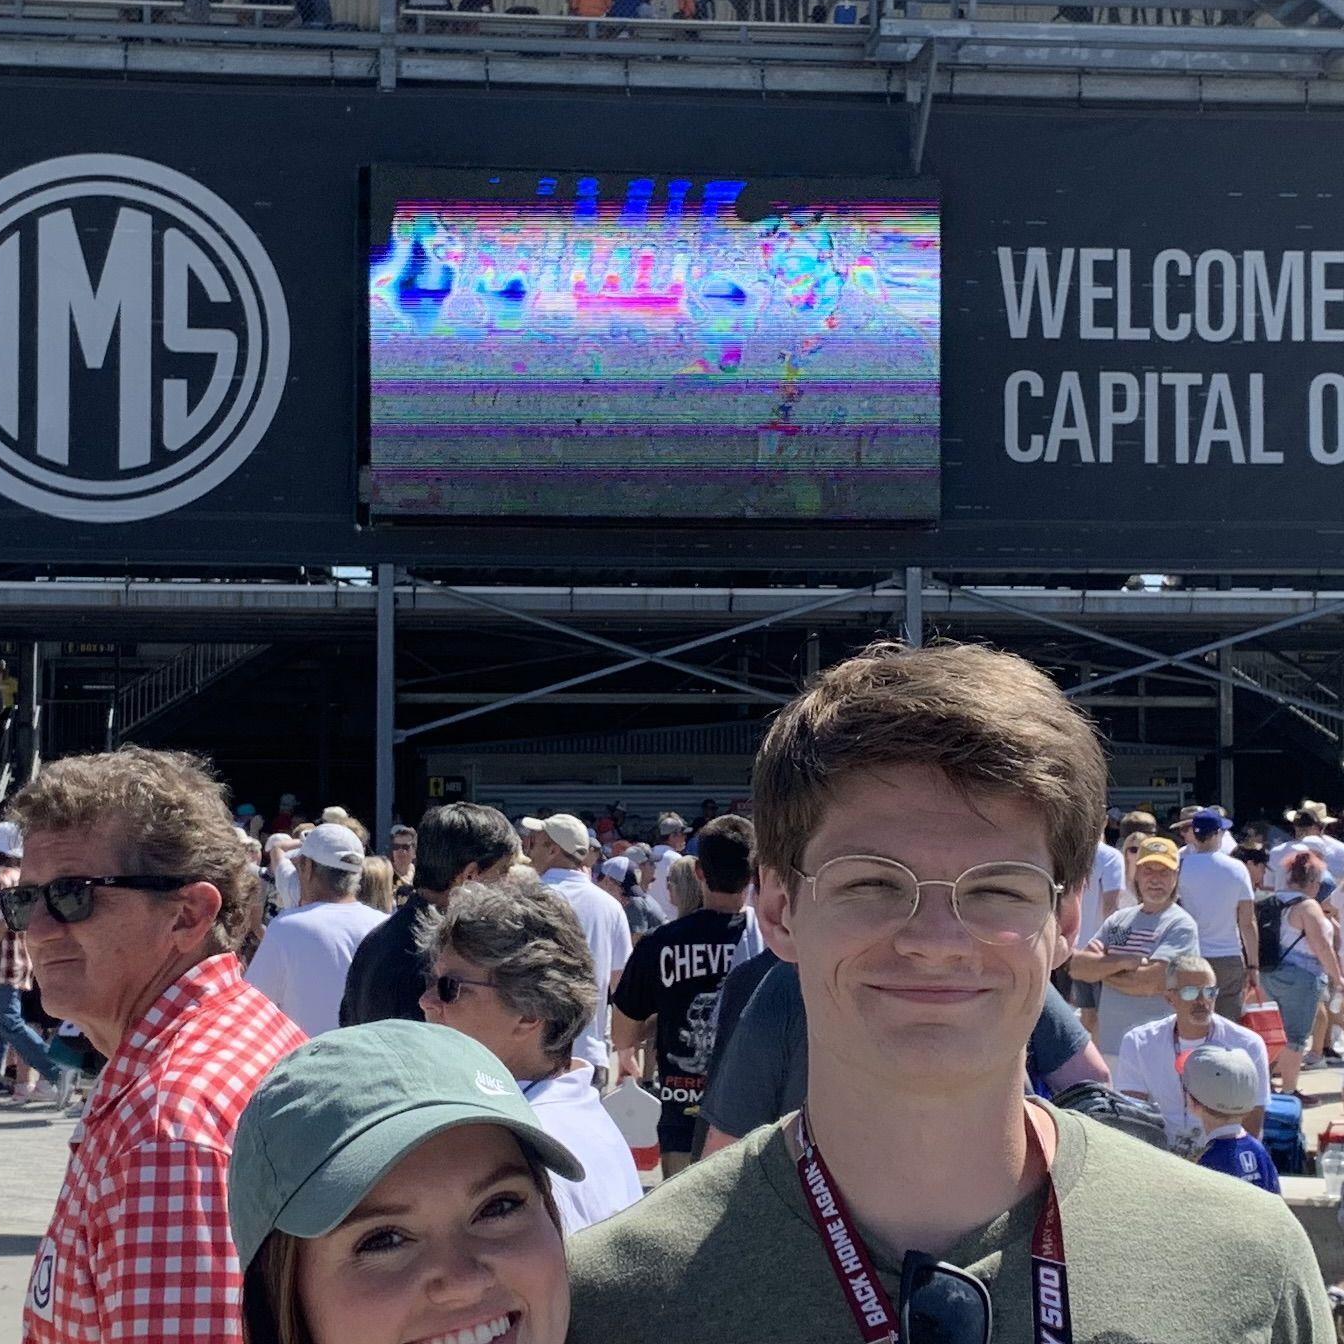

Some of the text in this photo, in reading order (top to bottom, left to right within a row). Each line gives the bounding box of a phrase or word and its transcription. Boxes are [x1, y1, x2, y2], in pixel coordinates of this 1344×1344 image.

[1004, 370, 1284, 464] CAPITAL
[826, 1216, 864, 1274] HOME
[848, 1271, 889, 1327] BACK
[1040, 1265, 1064, 1330] 500
